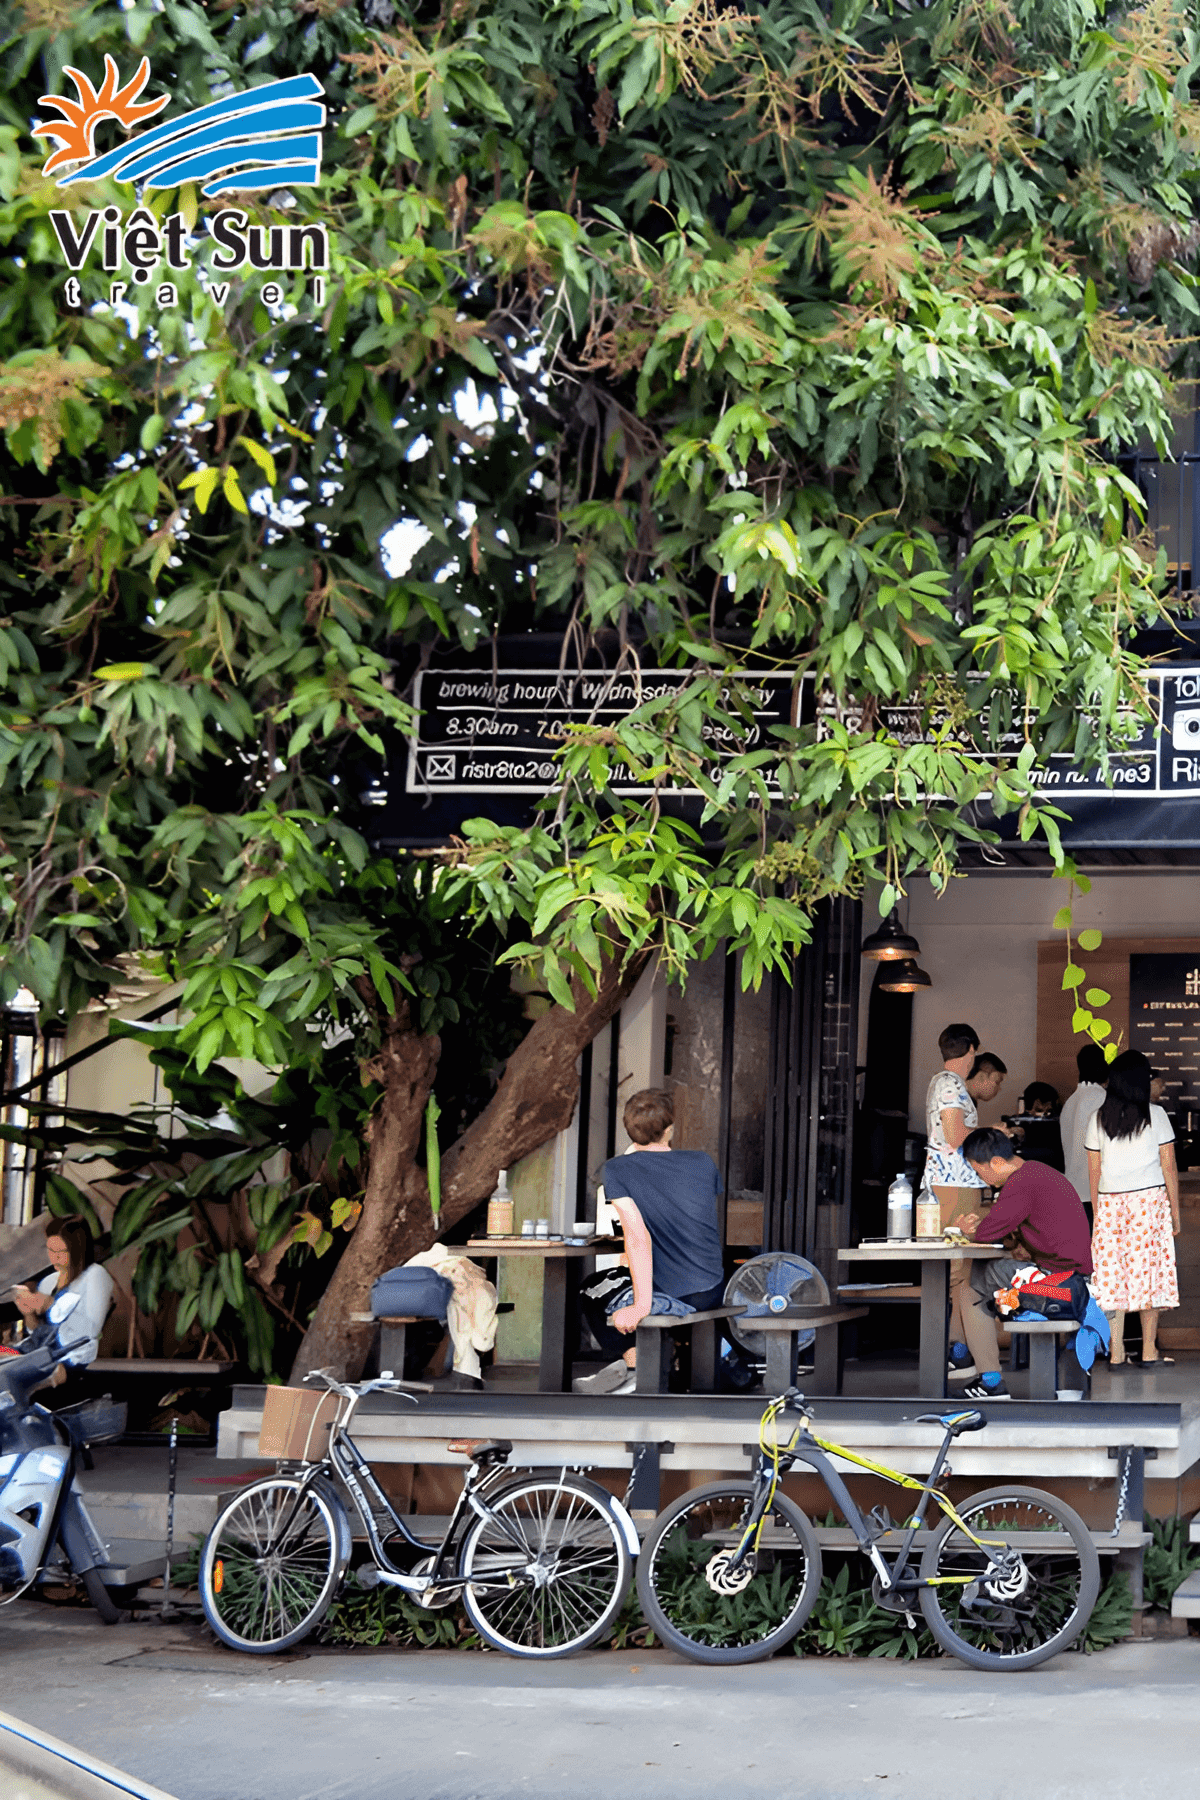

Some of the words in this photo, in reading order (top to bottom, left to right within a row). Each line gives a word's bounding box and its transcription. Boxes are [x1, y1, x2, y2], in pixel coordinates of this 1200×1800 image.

[438, 681, 510, 703] brewing
[513, 682, 557, 700] hour
[582, 683, 682, 702] Wdnsda
[446, 717, 519, 735] 8.30am
[1095, 764, 1151, 783] lne3
